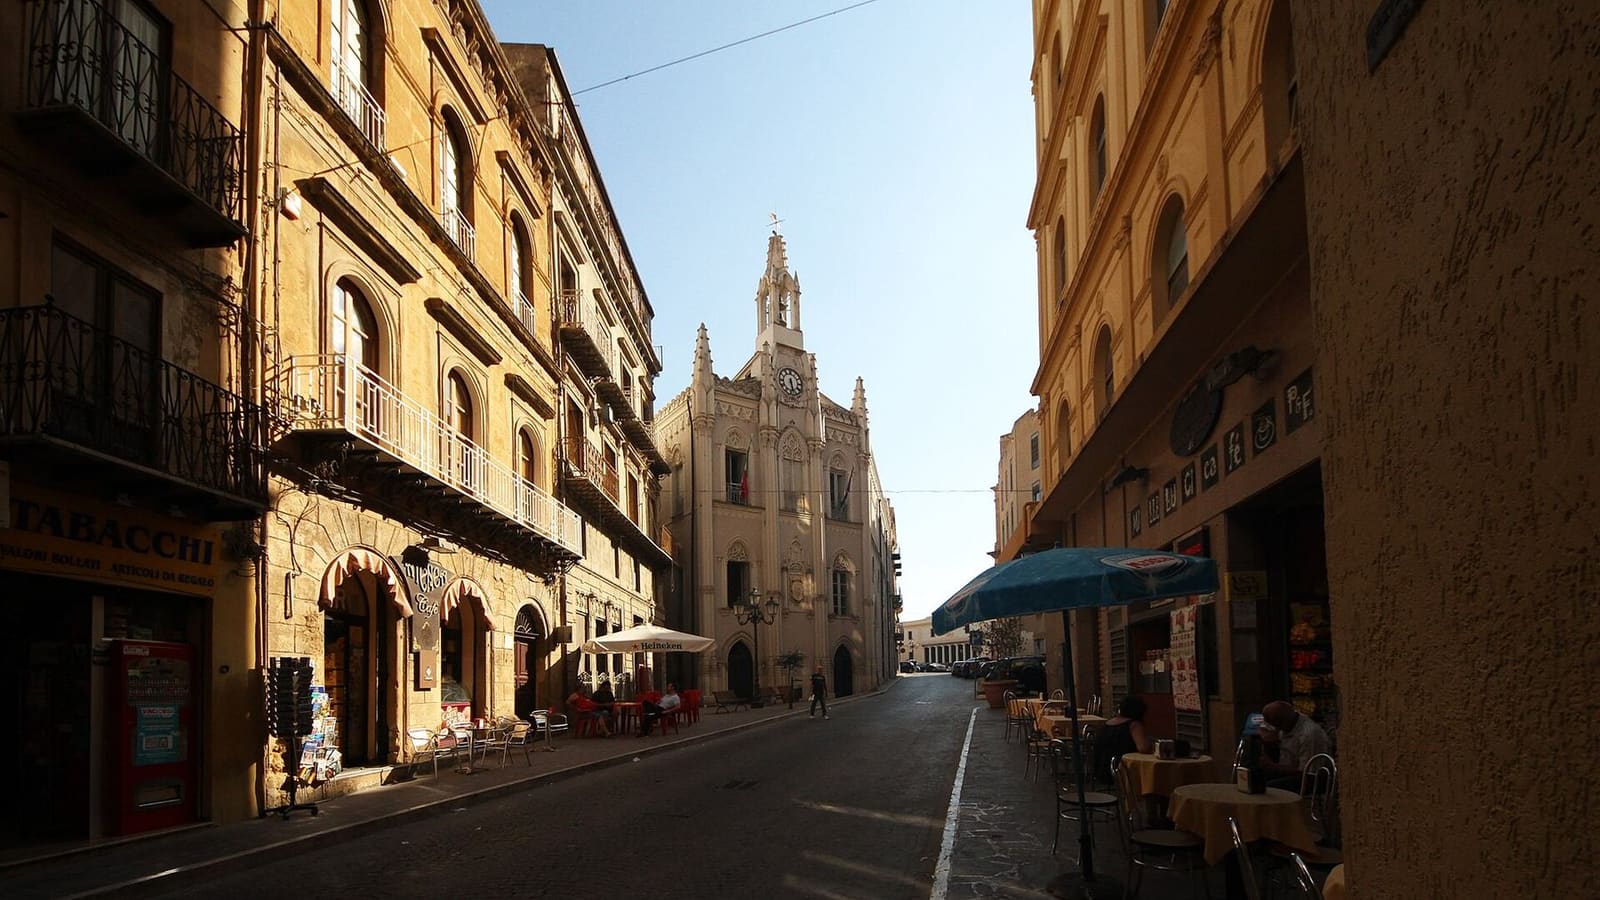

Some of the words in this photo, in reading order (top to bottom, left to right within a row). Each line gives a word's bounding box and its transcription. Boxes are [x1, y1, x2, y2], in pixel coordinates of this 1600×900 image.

[10, 496, 214, 565] TABACCHI
[0, 543, 48, 561] VALORI
[52, 554, 100, 570] BOLLATI
[111, 563, 160, 578] ARTICOLI
[162, 572, 176, 583] DA
[178, 573, 214, 587] REGALO
[641, 642, 682, 650] Heineken
